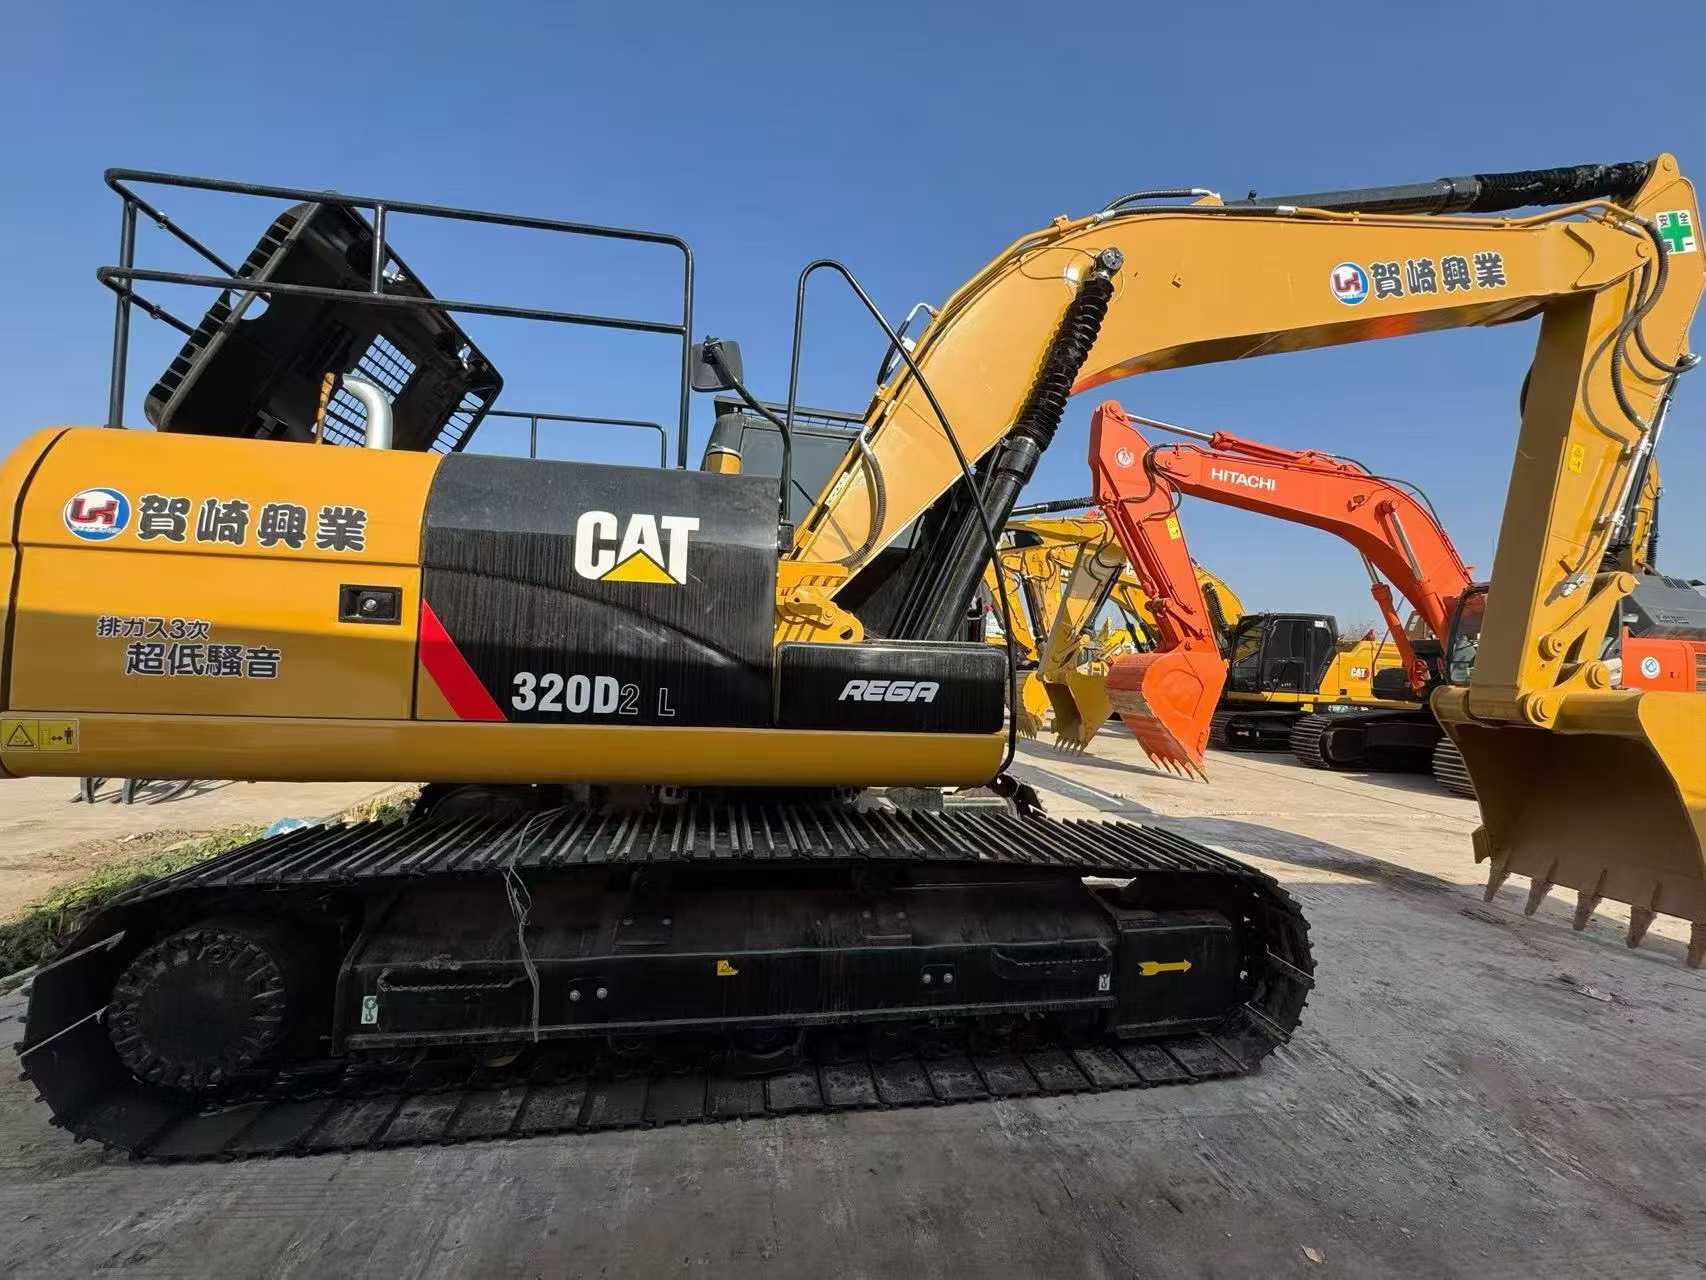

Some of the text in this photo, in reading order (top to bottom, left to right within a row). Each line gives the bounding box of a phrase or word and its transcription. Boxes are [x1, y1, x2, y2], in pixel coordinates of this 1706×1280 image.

[1371, 252, 1506, 299] 賀崎興業
[1211, 468, 1276, 490] HITACHI
[137, 495, 367, 551] 賀崎興業
[575, 511, 700, 585] CAT
[98, 616, 210, 640] 排ガス3次
[1351, 667, 1366, 678] CAT
[657, 687, 676, 717] L
[838, 679, 940, 703] REGA
